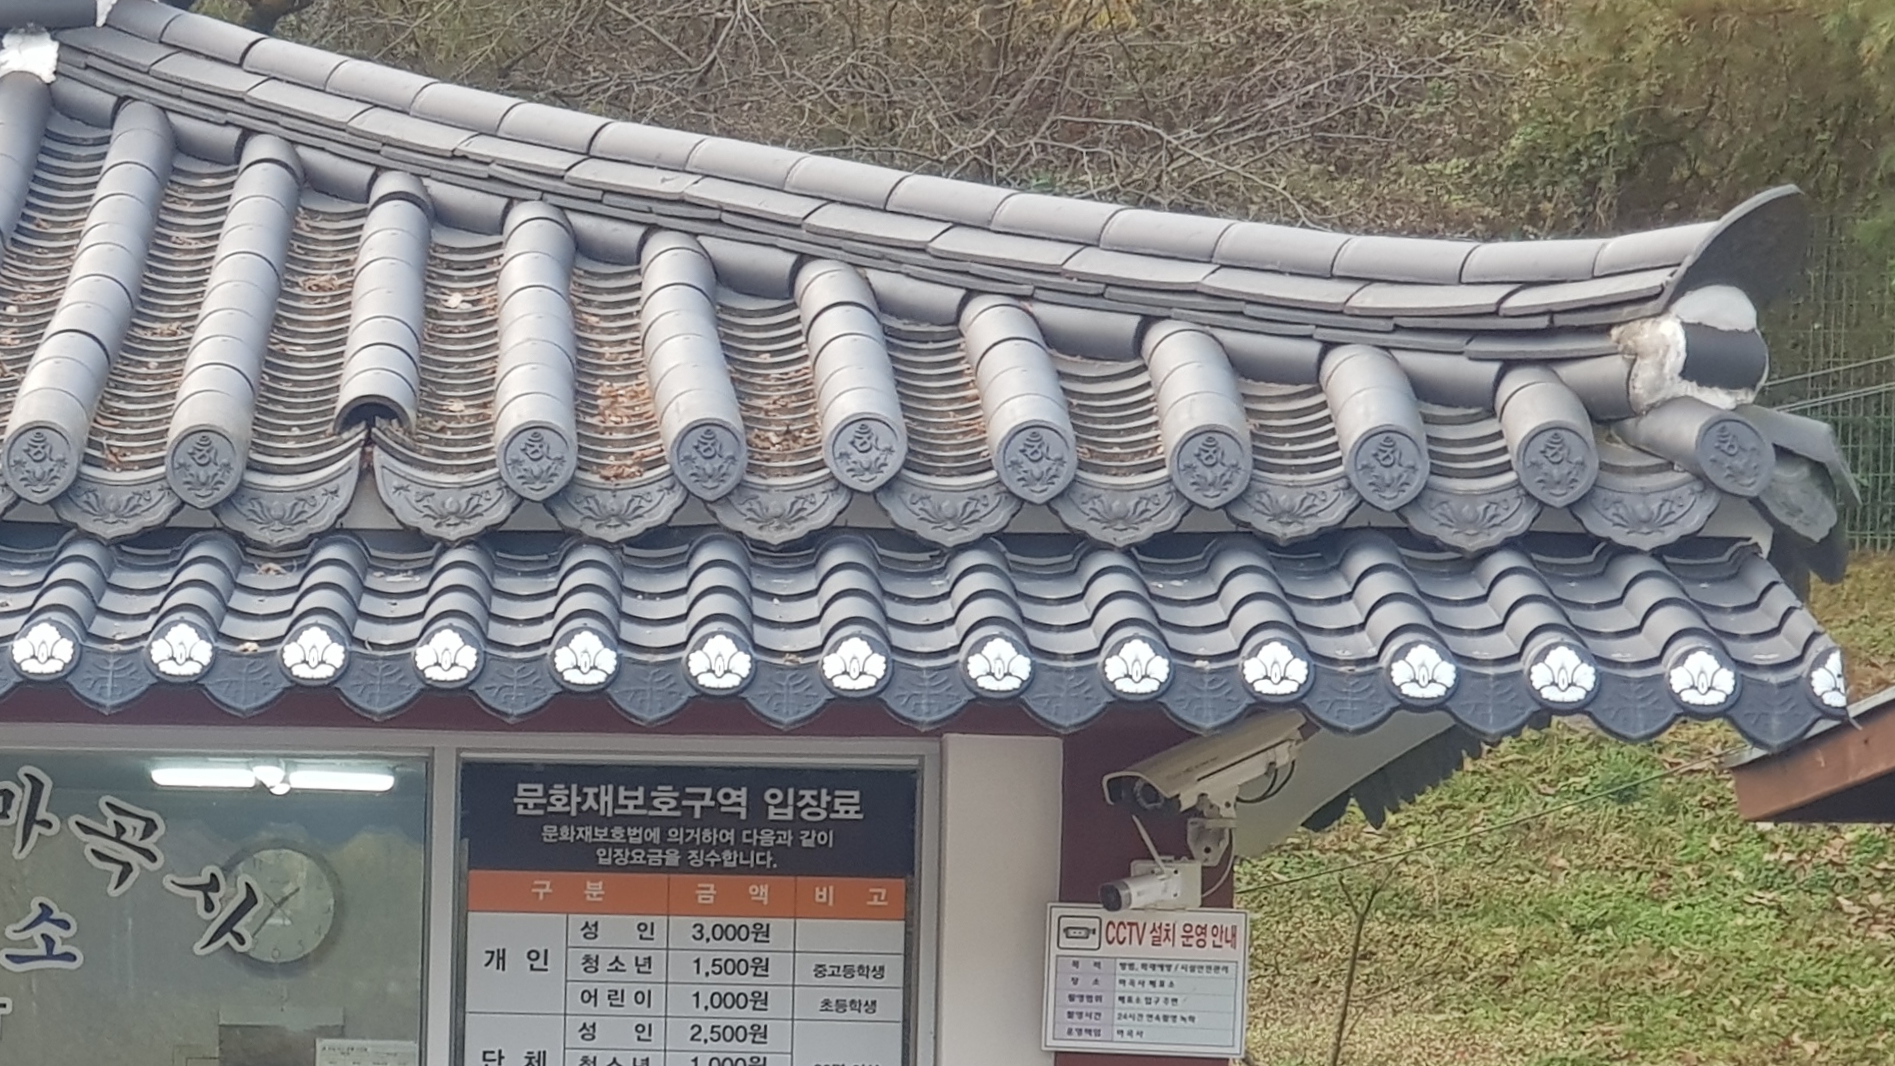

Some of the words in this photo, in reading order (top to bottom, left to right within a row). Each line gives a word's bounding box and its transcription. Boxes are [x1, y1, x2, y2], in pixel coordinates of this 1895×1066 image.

[513, 783, 748, 820] 문화재보호구역
[764, 788, 865, 820] 입장료
[542, 825, 660, 845] 문화재보호법에
[667, 827, 735, 847] 의거하여
[742, 828, 793, 847] 다음과
[800, 829, 834, 848] 같이
[596, 847, 680, 867] 입장요금을
[687, 849, 778, 869] 징수합니다.
[691, 922, 771, 944] 3,000원
[1106, 921, 1146, 945] CCTV
[1150, 922, 1176, 947] 설치
[1181, 923, 1208, 948] 운영
[1211, 925, 1238, 949] 안내
[580, 953, 653, 976] 청소년
[693, 956, 771, 978] 1,500원
[812, 963, 886, 980] 중고등학생
[580, 988, 653, 1010] 어린이
[692, 990, 769, 1012] 1,000원
[819, 998, 877, 1015] 초등학생
[689, 1023, 769, 1045] 2,500원
